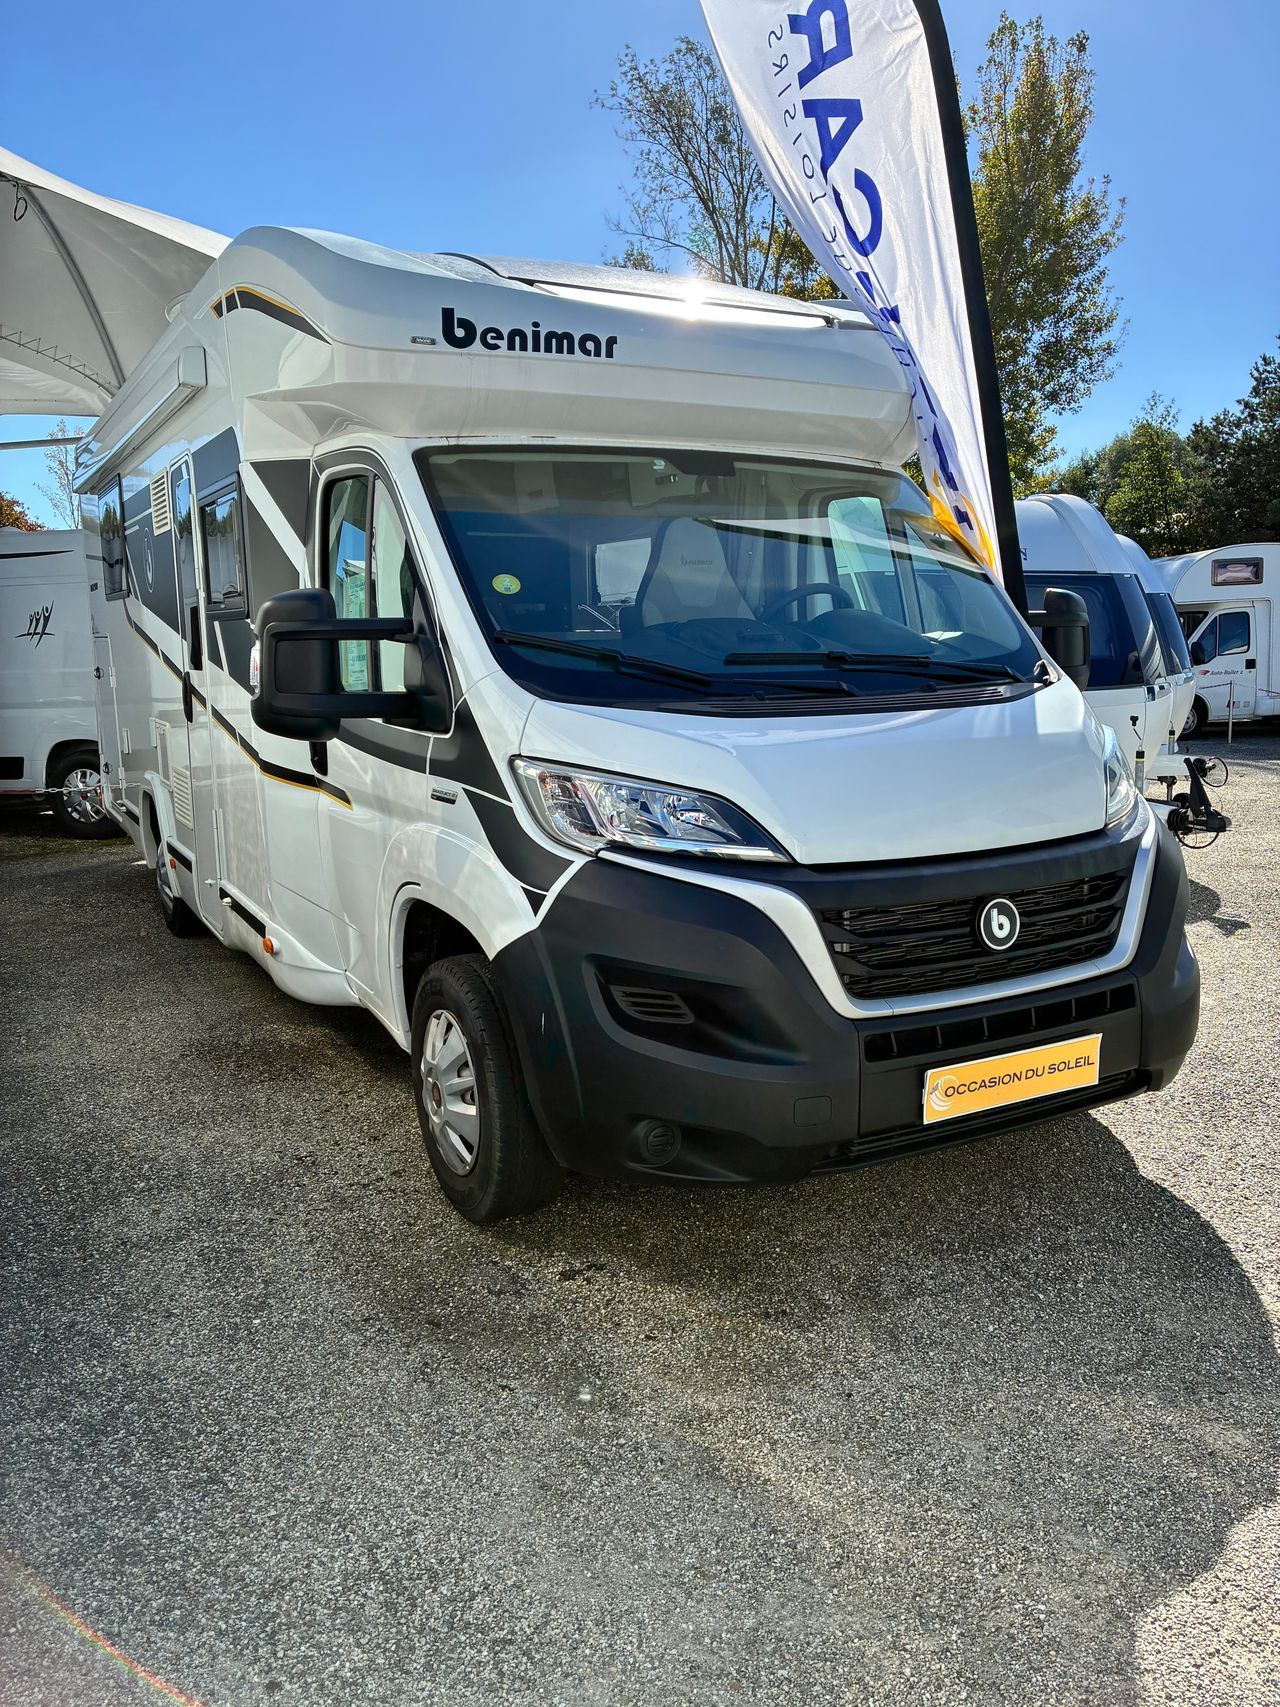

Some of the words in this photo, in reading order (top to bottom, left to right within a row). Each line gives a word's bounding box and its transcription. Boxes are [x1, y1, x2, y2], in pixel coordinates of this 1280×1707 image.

[441, 307, 618, 359] benimar
[944, 1071, 1022, 1098] OCCASION
[1025, 1066, 1046, 1080] DU
[1047, 1055, 1095, 1075] SOLEIL
